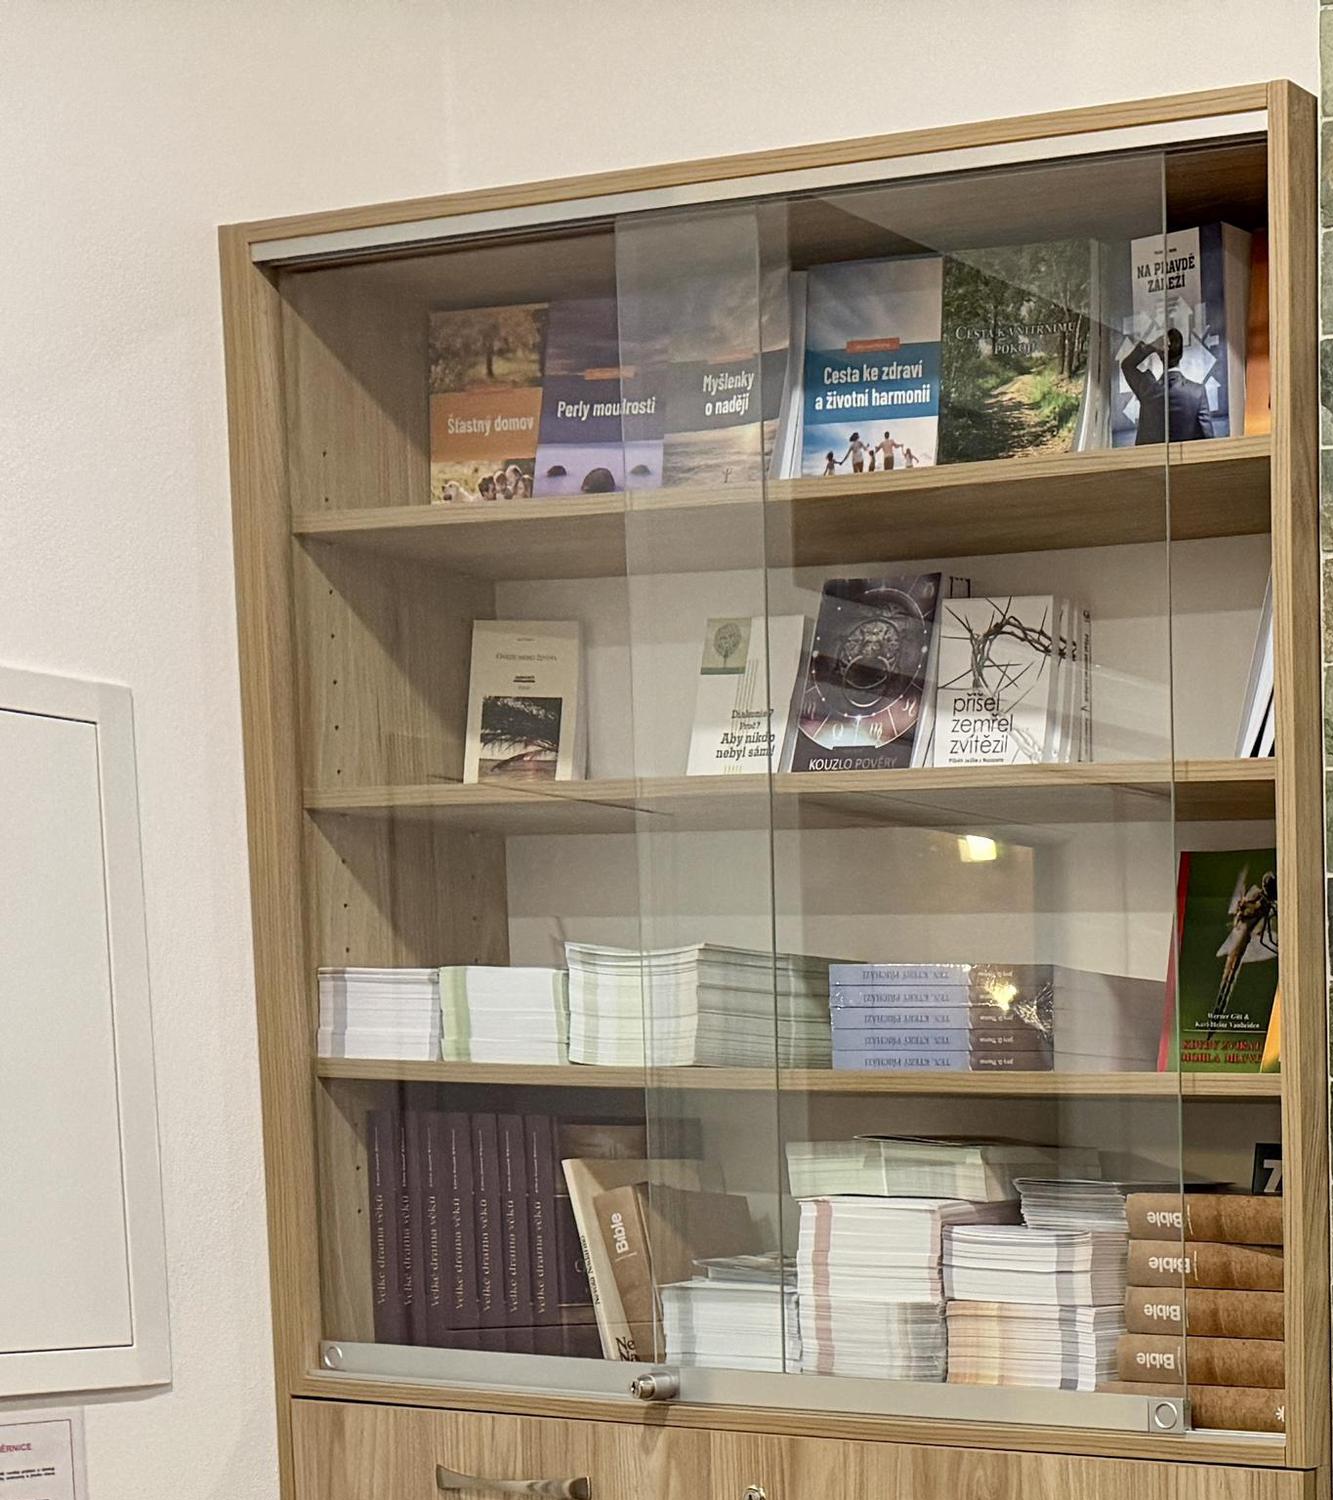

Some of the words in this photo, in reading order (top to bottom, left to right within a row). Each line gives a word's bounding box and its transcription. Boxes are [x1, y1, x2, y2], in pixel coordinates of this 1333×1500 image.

[703, 370, 755, 393] Myšlenky
[823, 365, 859, 385] Cesta
[863, 365, 878, 382] ke
[881, 362, 923, 382] zdraví
[705, 403, 713, 416] o
[715, 393, 749, 415] naději
[814, 397, 822, 410] a
[826, 389, 869, 408] životní
[871, 385, 930, 406] harmonii
[557, 400, 589, 420] Perly
[953, 693, 1000, 714] přišel
[951, 714, 1013, 733] zemřel
[720, 732, 743, 745] Aby
[745, 732, 775, 745] nikdo
[950, 735, 1008, 755] zvítězil
[809, 758, 852, 771] KOUZLO
[854, 756, 898, 769] POVĚRY
[610, 1212, 630, 1254] Bible
[1144, 1303, 1181, 1321] Bible
[1136, 1350, 1175, 1370] Bible
